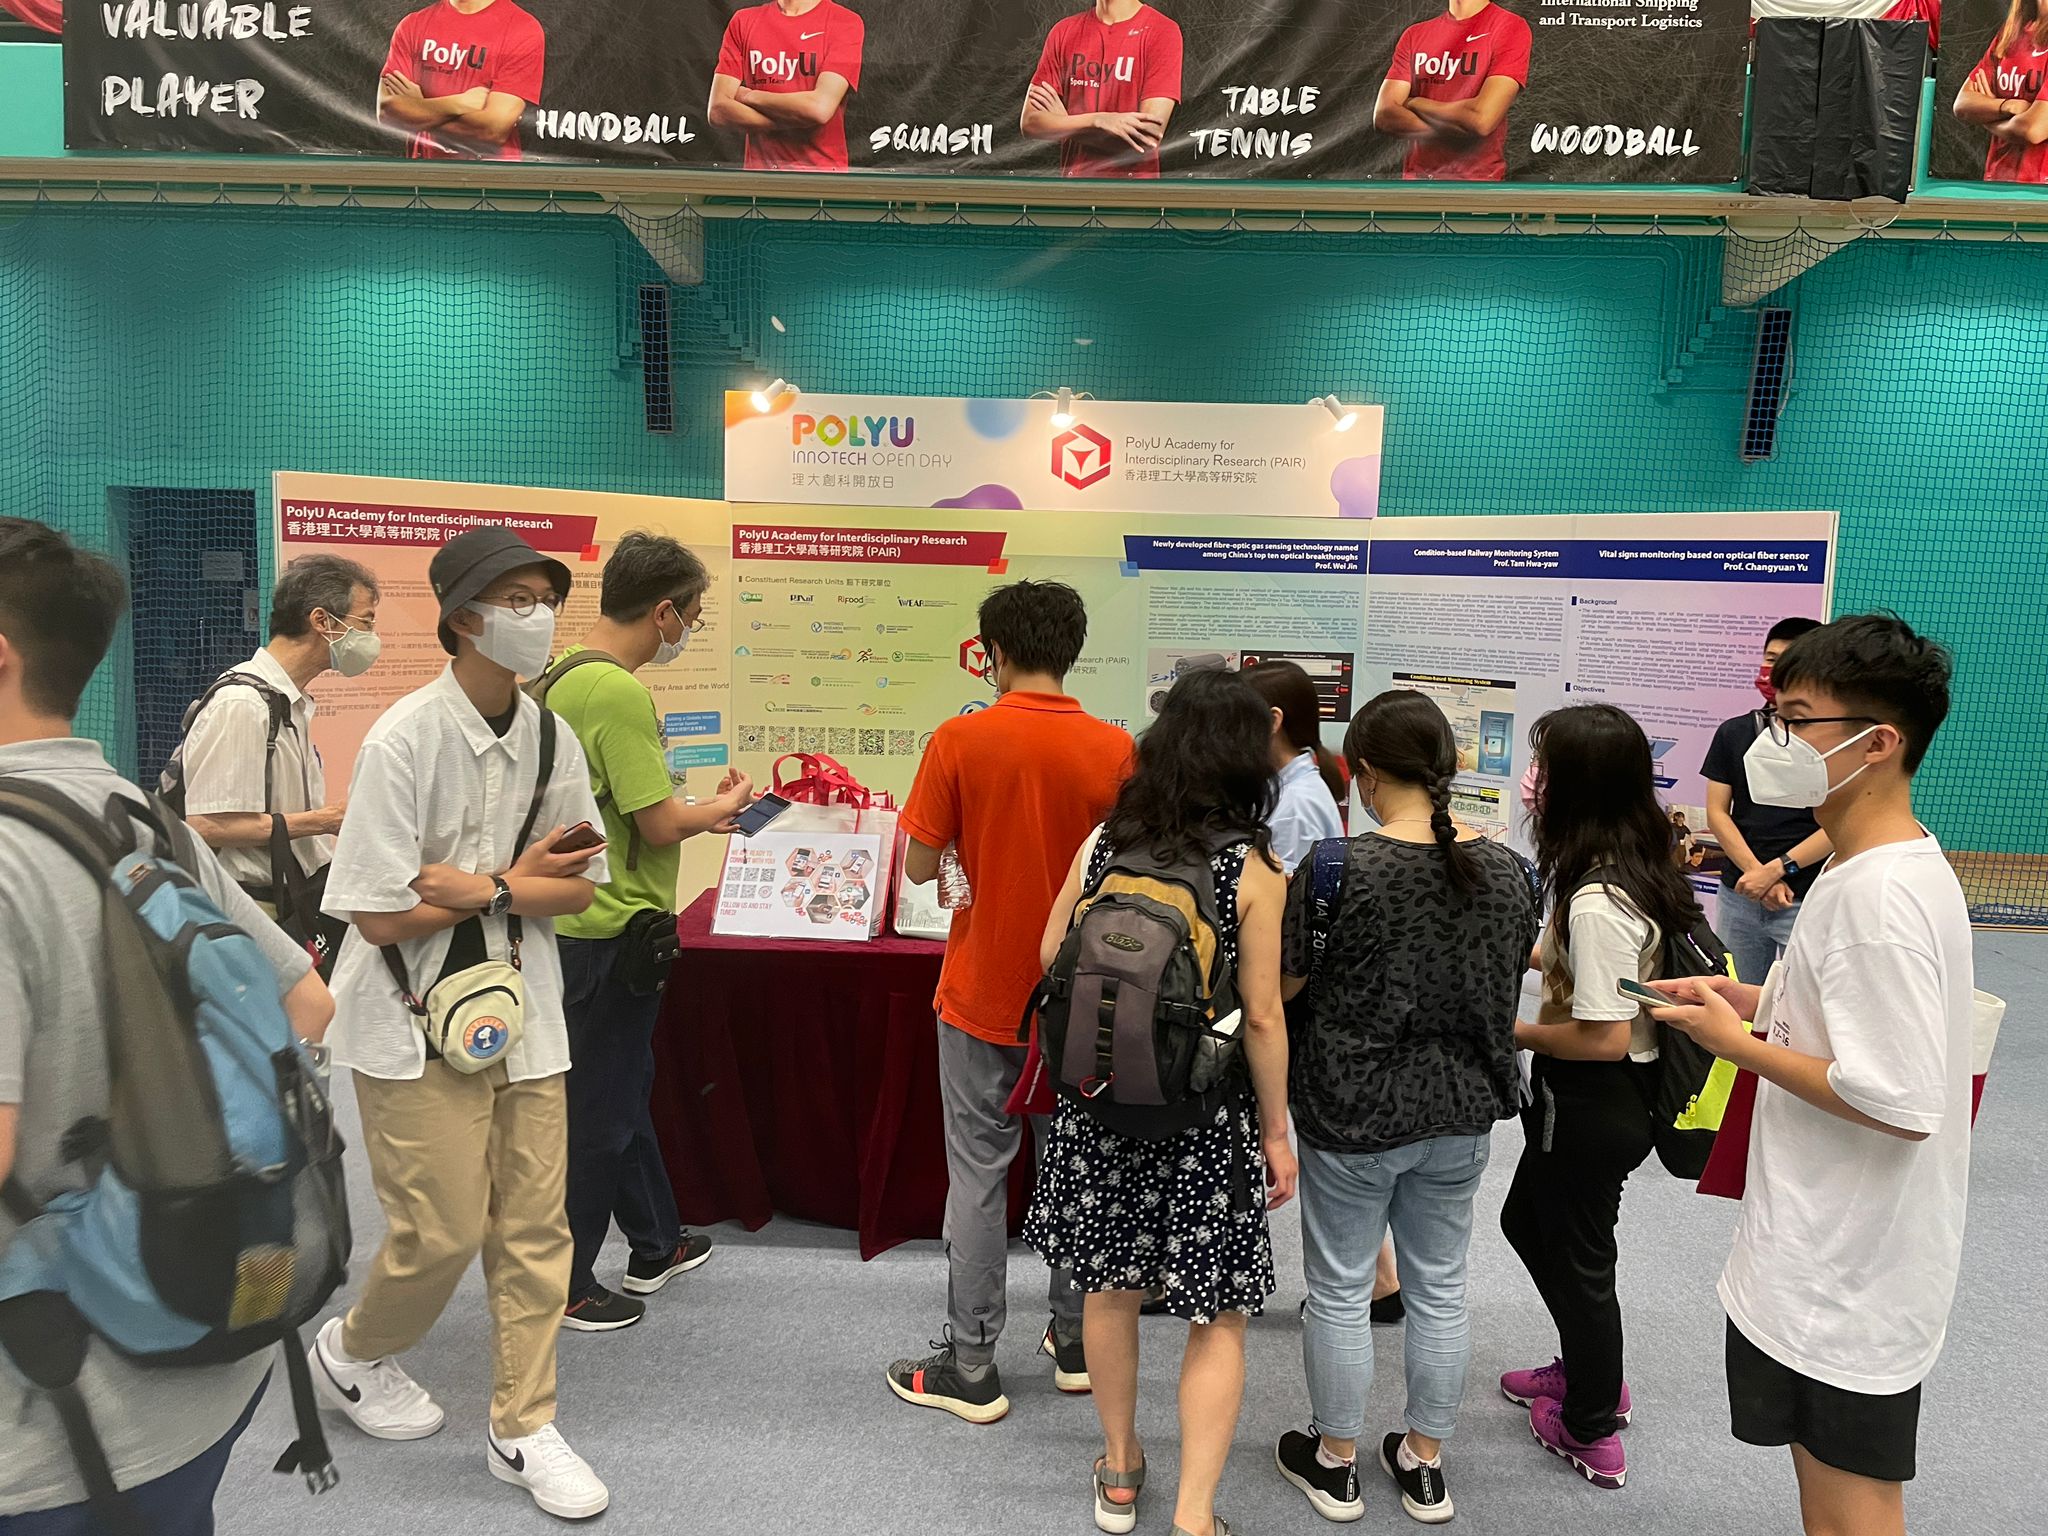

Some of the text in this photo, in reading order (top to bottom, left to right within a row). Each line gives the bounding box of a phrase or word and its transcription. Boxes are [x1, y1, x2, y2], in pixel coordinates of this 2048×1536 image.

[101, 0, 313, 42] VALUABLE
[1539, 12, 1702, 30] and Transport Logistics
[422, 39, 487, 70] PolyU
[750, 50, 816, 80] PolyU
[1415, 51, 1478, 80] PolyU
[101, 72, 265, 120] PLAYER
[1221, 84, 1321, 117] TABLE
[535, 108, 696, 145] HANDBALL
[869, 122, 993, 156] SQUASH
[1188, 127, 1313, 160] TENNIS
[1530, 122, 1700, 158] WOODBALL
[792, 414, 914, 448] POLYU
[1125, 436, 1235, 452] PolyU Academy for
[872, 452, 915, 467] OPEN
[919, 453, 952, 468] DAY
[1125, 453, 1307, 469] Interdisciplinary Research (PAIR)
[792, 472, 894, 488] 理大創科開放日
[1125, 469, 1257, 483] 香港理工大學高等研究院
[286, 506, 553, 529] PolyU Academy for Interdisciplinary Research
[287, 521, 440, 541] 香港理工大學高等研究院
[739, 530, 967, 546] PolyU Academy for Interdisciplinary Research
[739, 542, 901, 558] 香港理工大學高等研究院 (PAIR)
[1153, 540, 1175, 549] Newly
[1175, 541, 1212, 550] developed
[1213, 541, 1250, 550] fibre-optic
[1265, 543, 1292, 551] sensing
[1293, 543, 1333, 552] technology
[1413, 549, 1559, 559] Condition-based Railway Monitoring System
[1202, 552, 1227, 560] among
[1254, 552, 1266, 560] top
[1280, 552, 1304, 560] optical
[1305, 552, 1358, 561] breakthroughs
[1599, 550, 1617, 558] Vital
[1618, 550, 1639, 560] signs
[1639, 550, 1686, 560] monitoring
[1687, 551, 1712, 559] based
[1726, 551, 1756, 561] optical
[1757, 551, 1778, 560] fiber
[1315, 562, 1332, 570] Prof.
[1333, 562, 1346, 570] Wei
[1525, 560, 1559, 568] Hwa-yaw
[1723, 562, 1809, 573] Prof. Changyuan Yu
[745, 575, 787, 584] Constituent
[789, 577, 823, 585] Research
[825, 578, 844, 586] Units
[1579, 598, 1617, 606] Background
[1105, 656, 1130, 665] (PAIR)
[653, 684, 666, 692] Bay
[1572, 685, 1606, 694] Objectives
